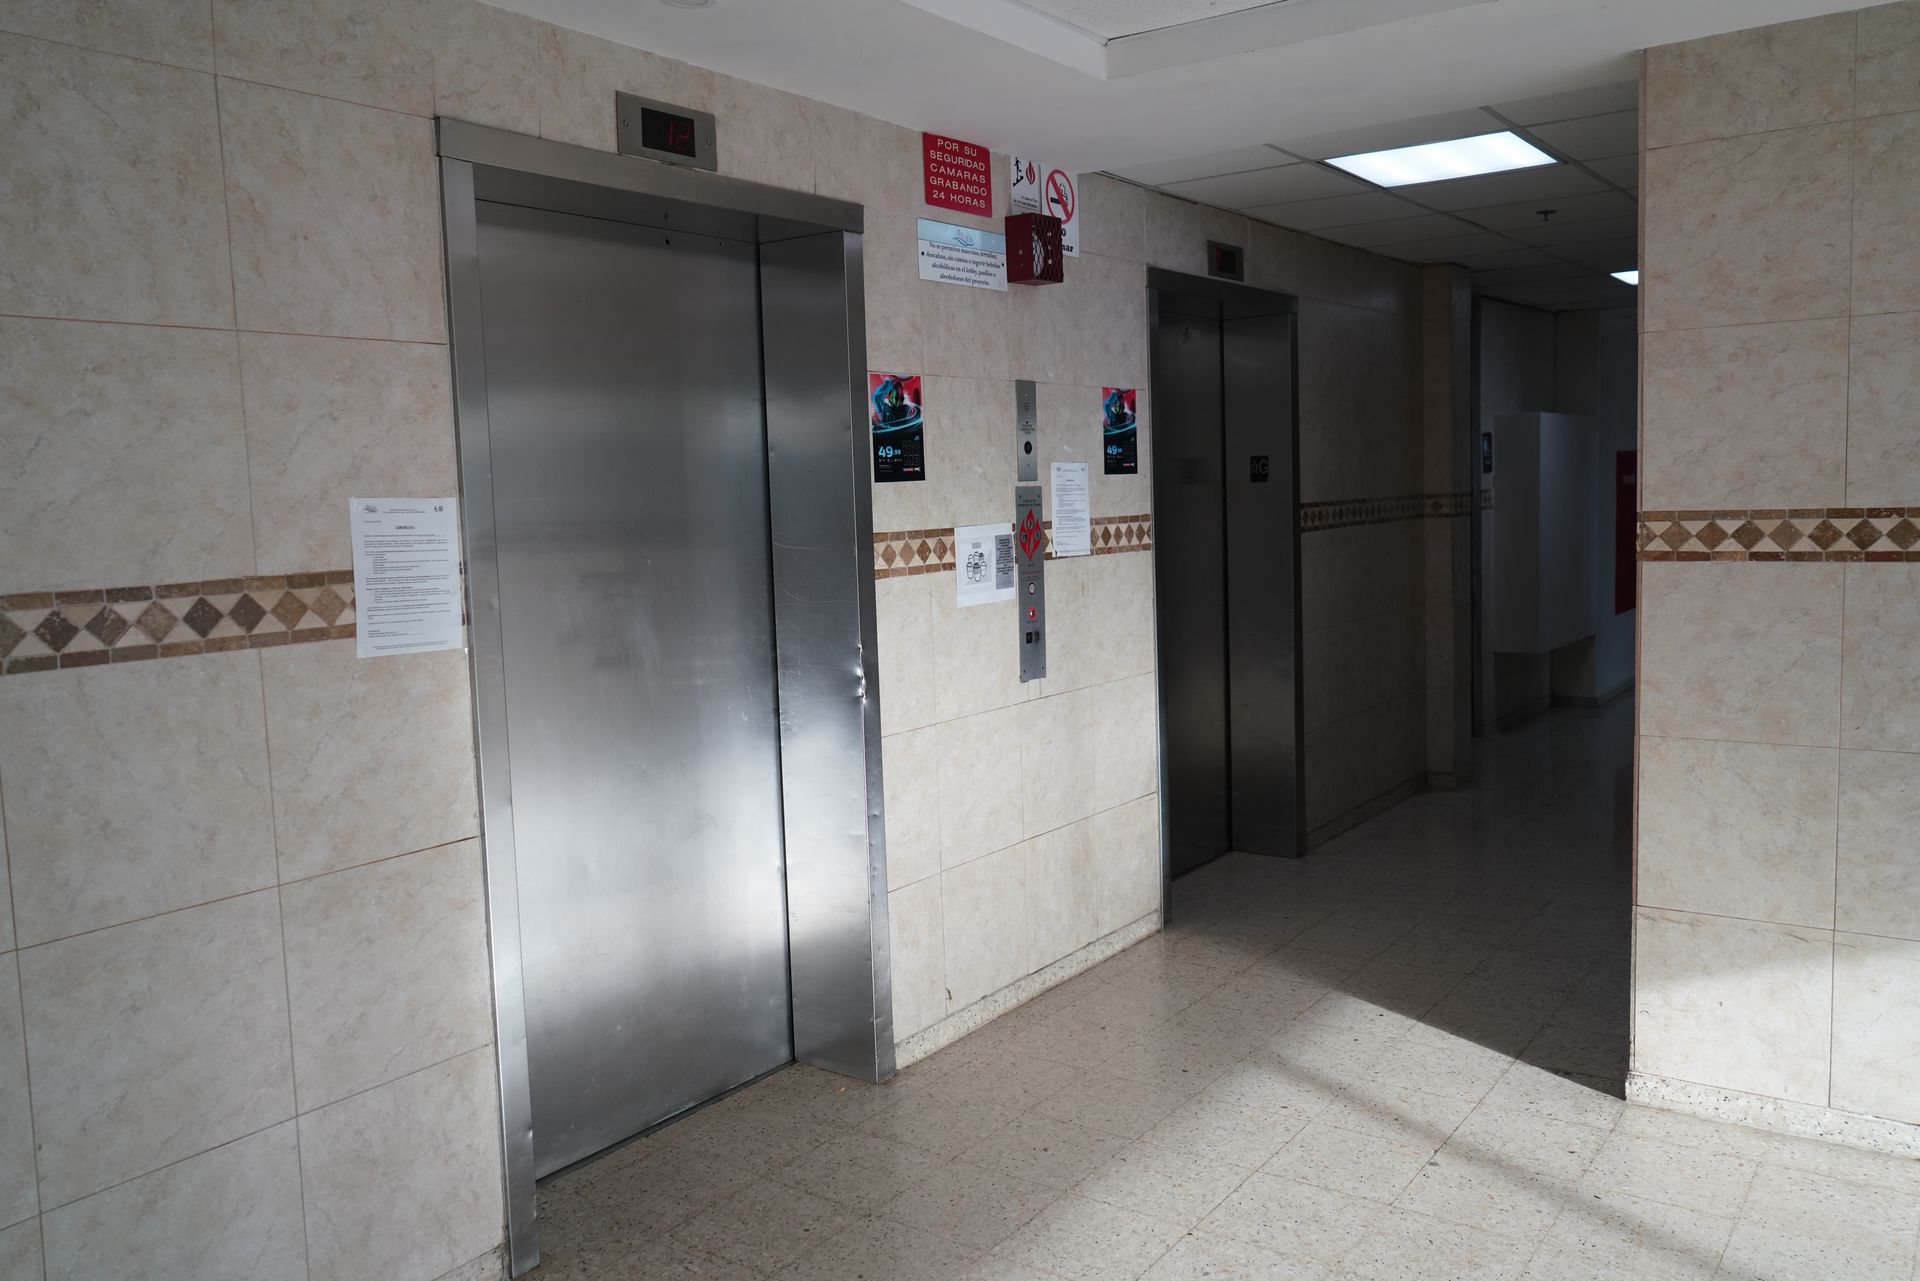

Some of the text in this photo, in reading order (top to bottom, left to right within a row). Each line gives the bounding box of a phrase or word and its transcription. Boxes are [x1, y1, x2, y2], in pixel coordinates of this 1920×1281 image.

[667, 120, 692, 153] 12
[937, 138, 977, 157] POR SU
[929, 149, 985, 171] SEGURIDAD
[930, 163, 986, 184] CAMARAS
[929, 175, 987, 196] GRABANDO
[932, 189, 986, 208] 24 HORAS
[929, 240, 936, 249] No
